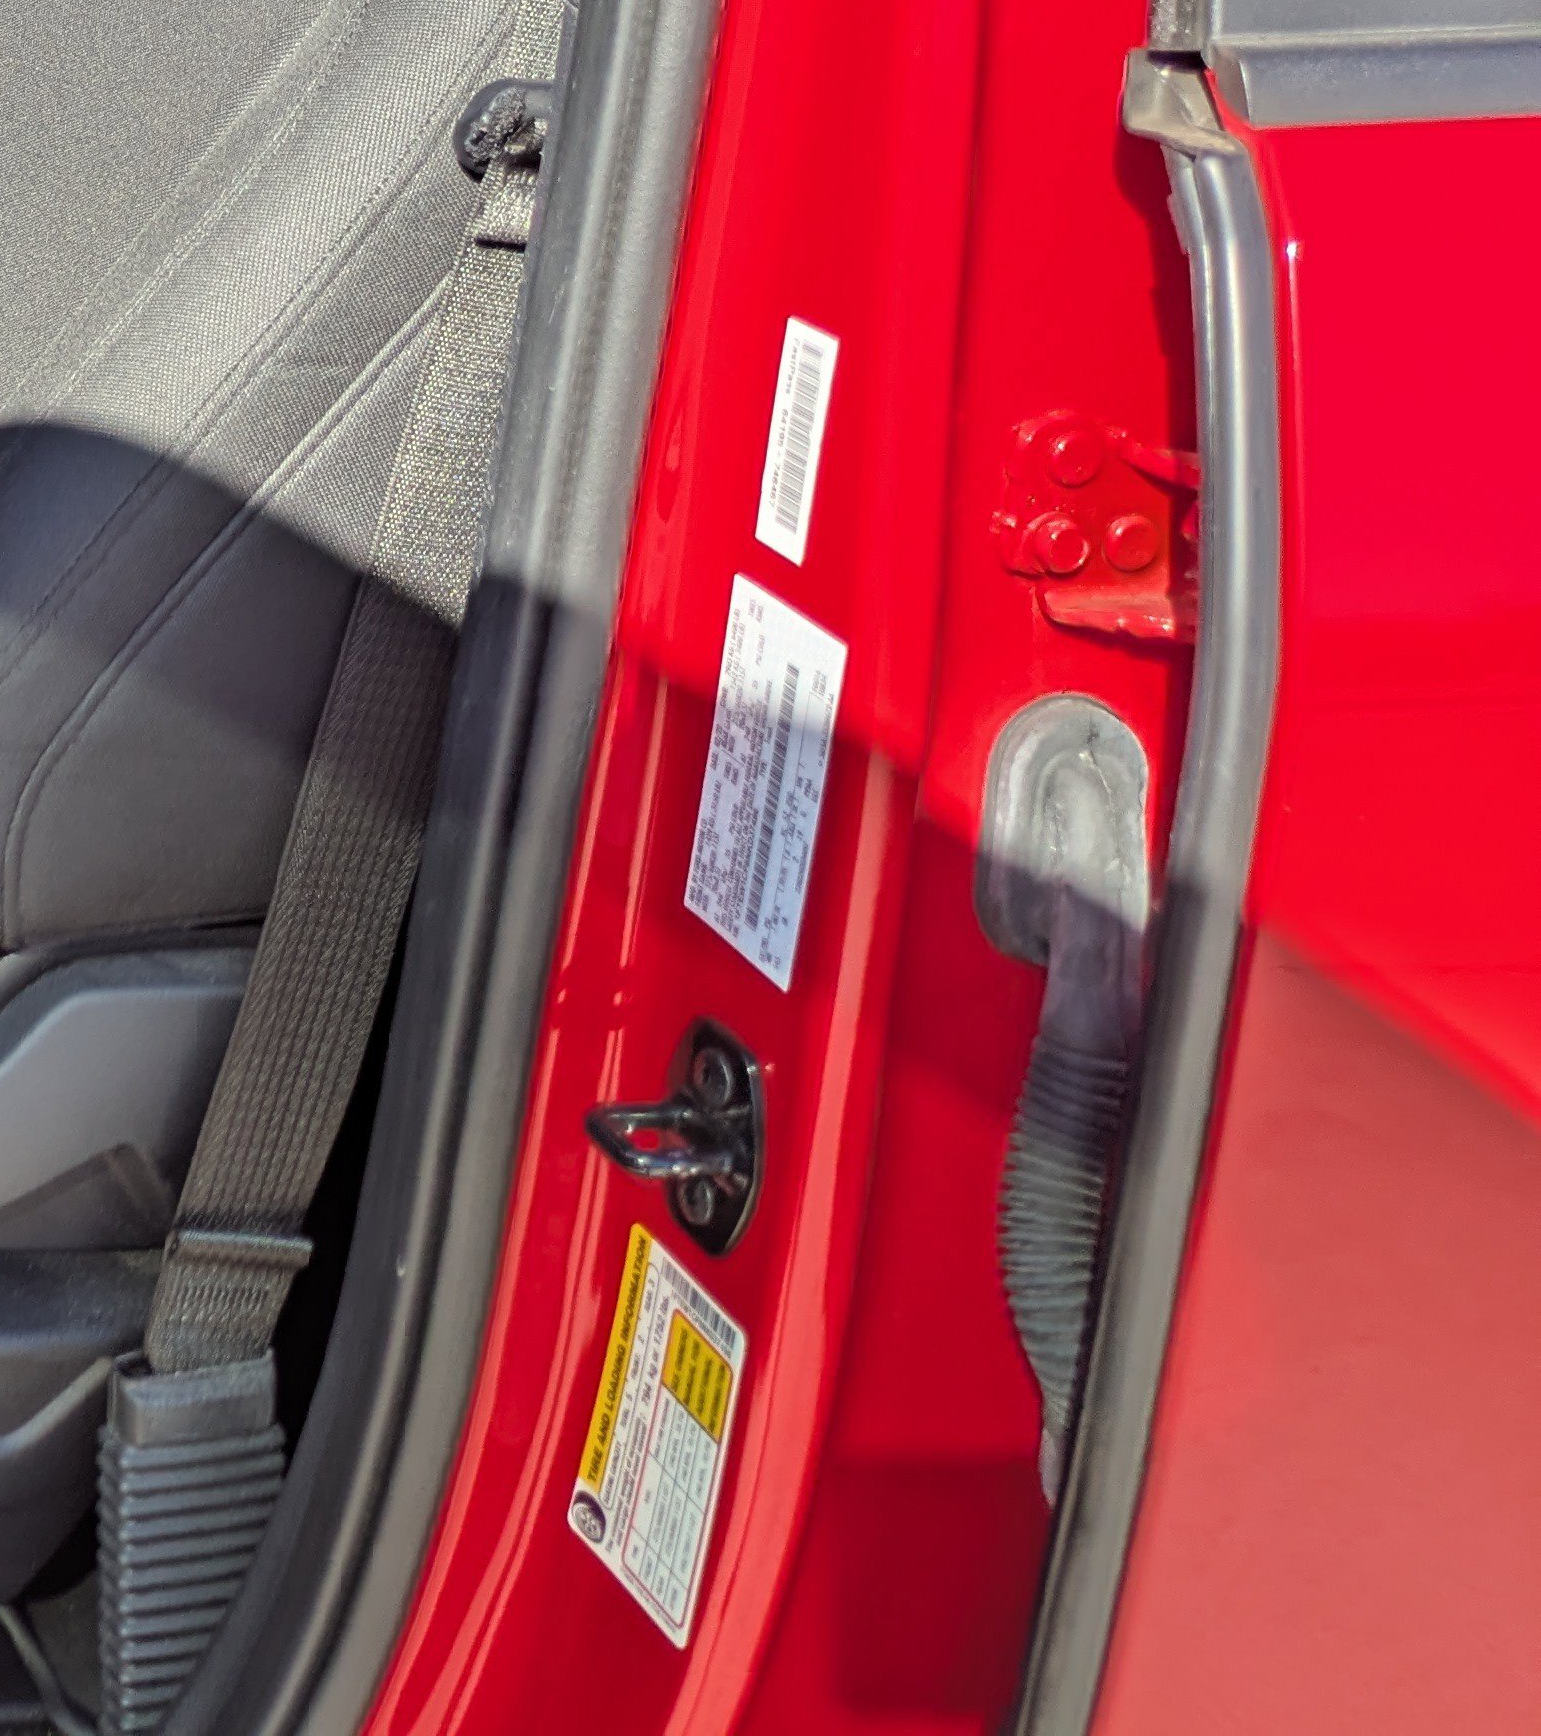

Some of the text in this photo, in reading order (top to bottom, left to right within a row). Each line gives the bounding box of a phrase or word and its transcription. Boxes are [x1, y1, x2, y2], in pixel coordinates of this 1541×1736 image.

[586, 1233, 648, 1487] TIRE AND LOADING INFORMATION
